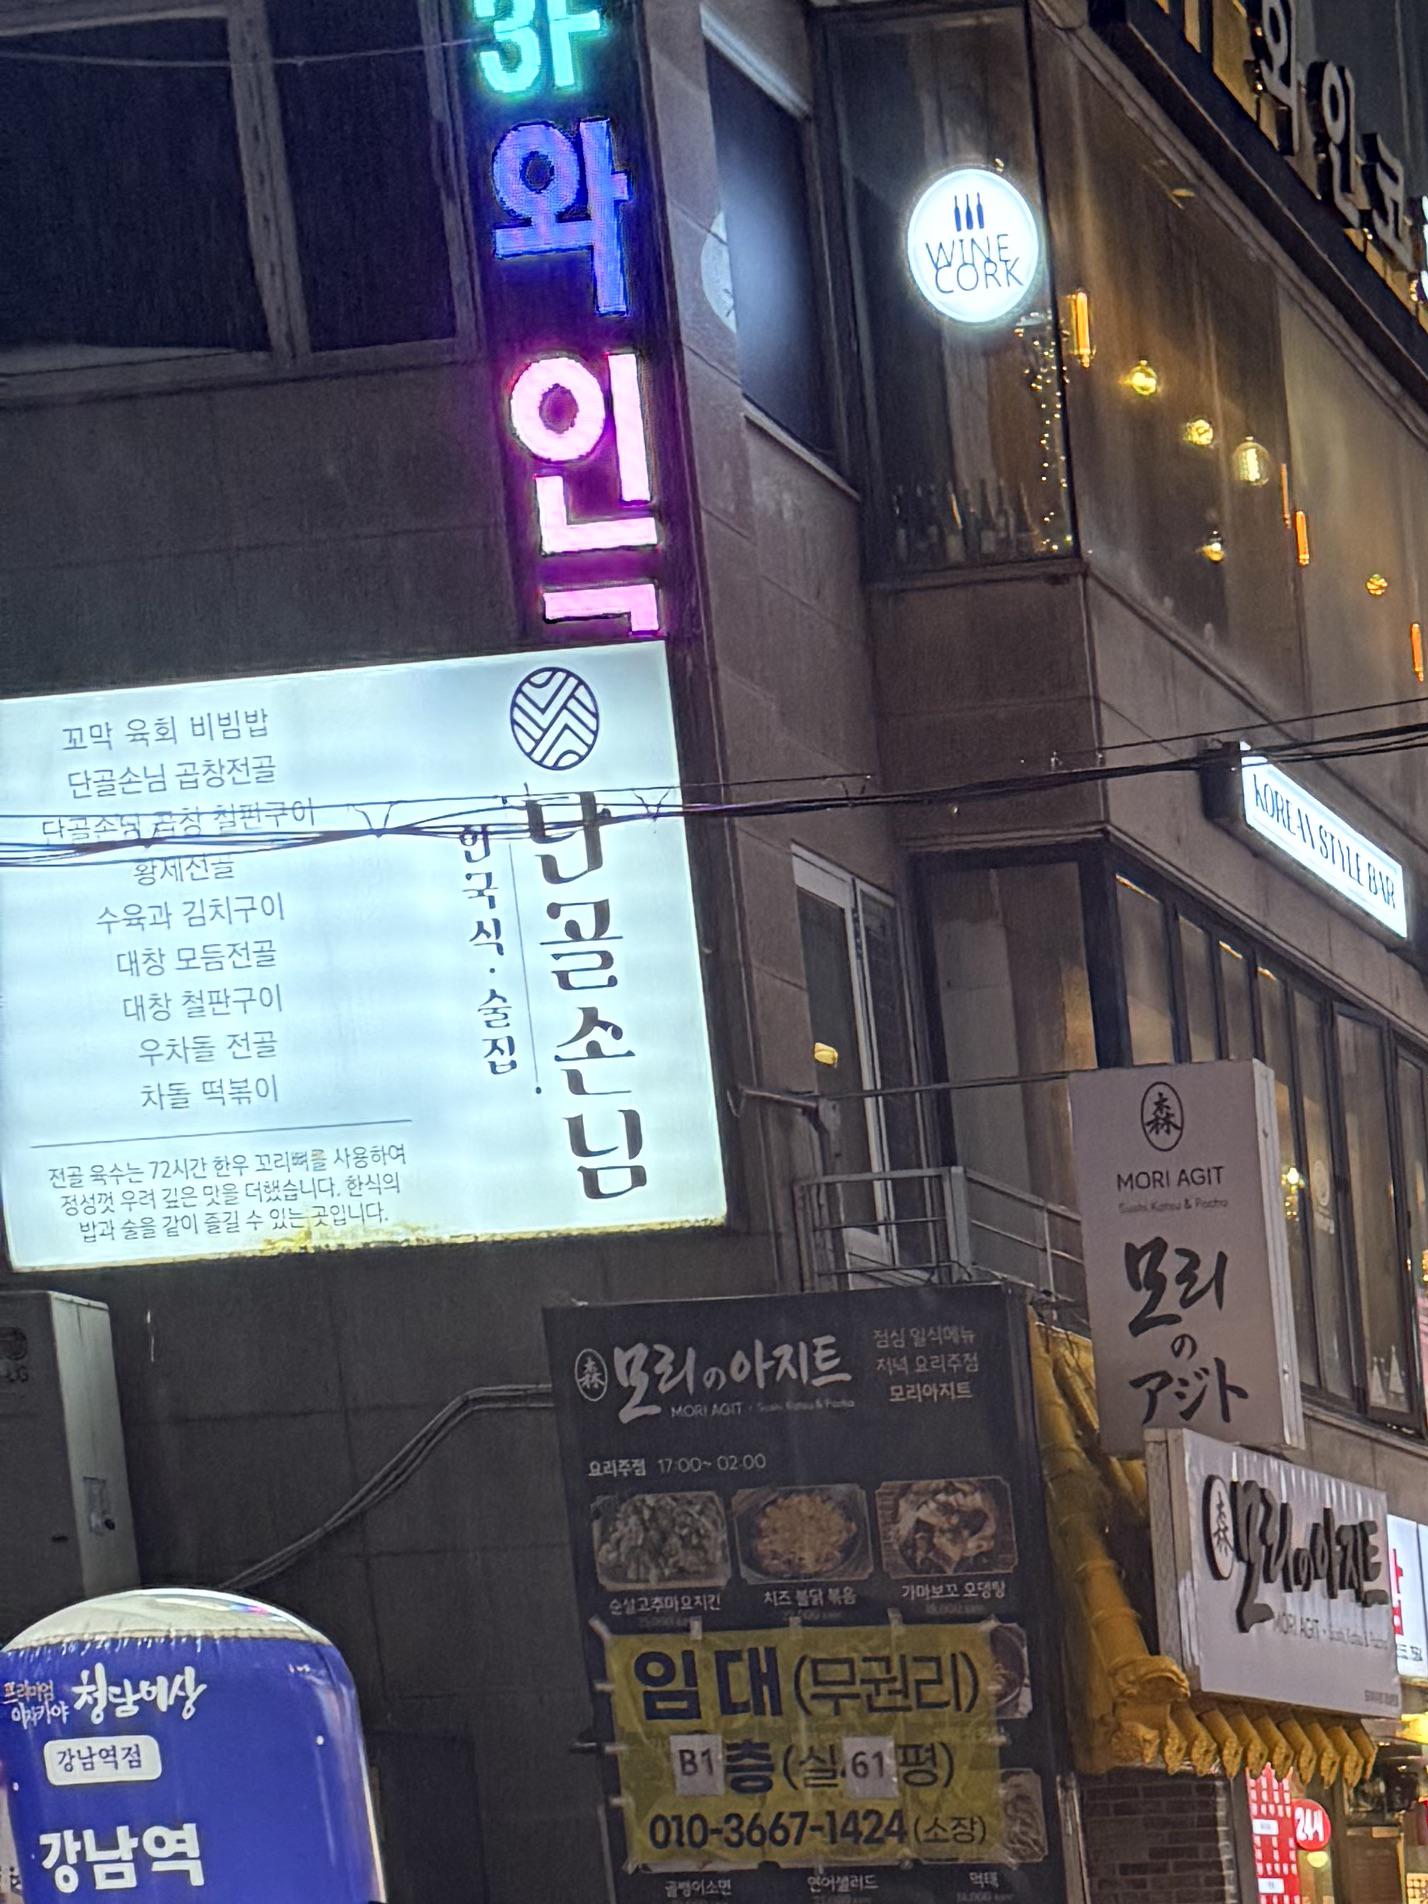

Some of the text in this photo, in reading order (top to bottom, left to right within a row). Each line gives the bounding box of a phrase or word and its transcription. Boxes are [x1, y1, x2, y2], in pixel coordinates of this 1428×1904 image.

[926, 233, 1012, 267] WINE
[934, 258, 1025, 296] CORK
[61, 707, 269, 751] 꼬막 육회 비빔밥
[67, 754, 277, 800] 단골손님 곱창전골
[1252, 773, 1397, 910] KOREAN STYLE BAR
[96, 891, 285, 935] 수육과 김치구이
[117, 939, 277, 978] 대창 모듬전골
[460, 824, 517, 1076] 한국식 술집
[122, 983, 283, 1023] 대창 철판구이
[524, 788, 648, 1200] 단골손님
[226, 1031, 278, 1060] 전골
[140, 1073, 279, 1111] 차돌 떡볶이
[1144, 1092, 1181, 1140] 森
[48, 1142, 407, 1190] 전골 육수는 72시간 한우 꼬리뼈를 사용하여
[1116, 1165, 1225, 1193] MORI AGIT
[60, 1170, 402, 1218] 정성껏 우려 깊은 맛을 더했습니다. 한식의
[79, 1200, 389, 1244] 밥과 술을 같이 즐길 수 있는 곳입니다.
[1123, 1235, 1228, 1338] 모리
[915, 1352, 979, 1375] 요리주점
[1171, 1331, 1197, 1363] の
[671, 1402, 708, 1418] MORI
[889, 1380, 974, 1403] 모리아지트
[1127, 1356, 1249, 1425] アジト
[588, 1458, 646, 1479] 요리주점
[71, 1662, 207, 1725] 청담이상
[632, 1645, 981, 1722] 임대 (무권리)
[56, 1742, 143, 1772] 강남역점
[649, 1809, 987, 1850] 010-3667-1424 (소장)
[39, 1822, 206, 1895] 강남역
